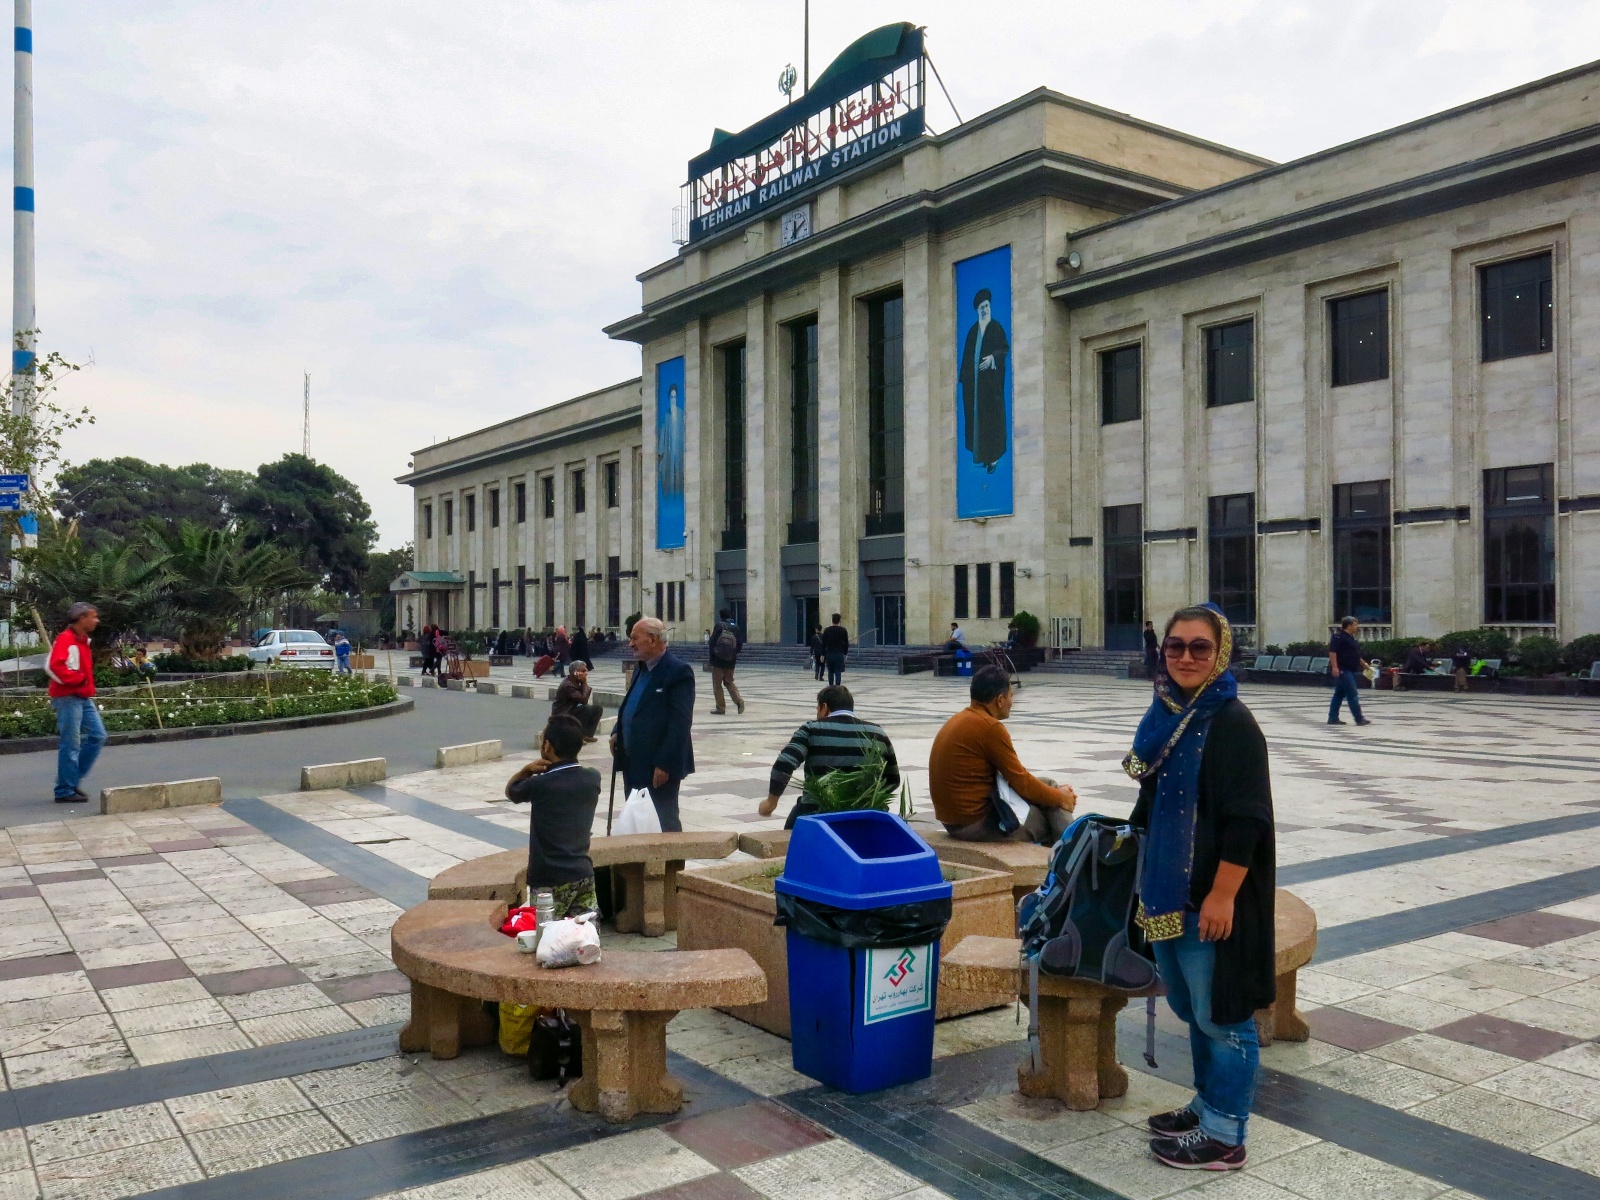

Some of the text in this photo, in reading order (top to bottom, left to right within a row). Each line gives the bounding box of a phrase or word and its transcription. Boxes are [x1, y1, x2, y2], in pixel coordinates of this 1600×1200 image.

[826, 80, 902, 139] ایستگاه
[700, 120, 902, 231] TEHRAN RAILWAY STATION
[702, 163, 749, 207] تهران
